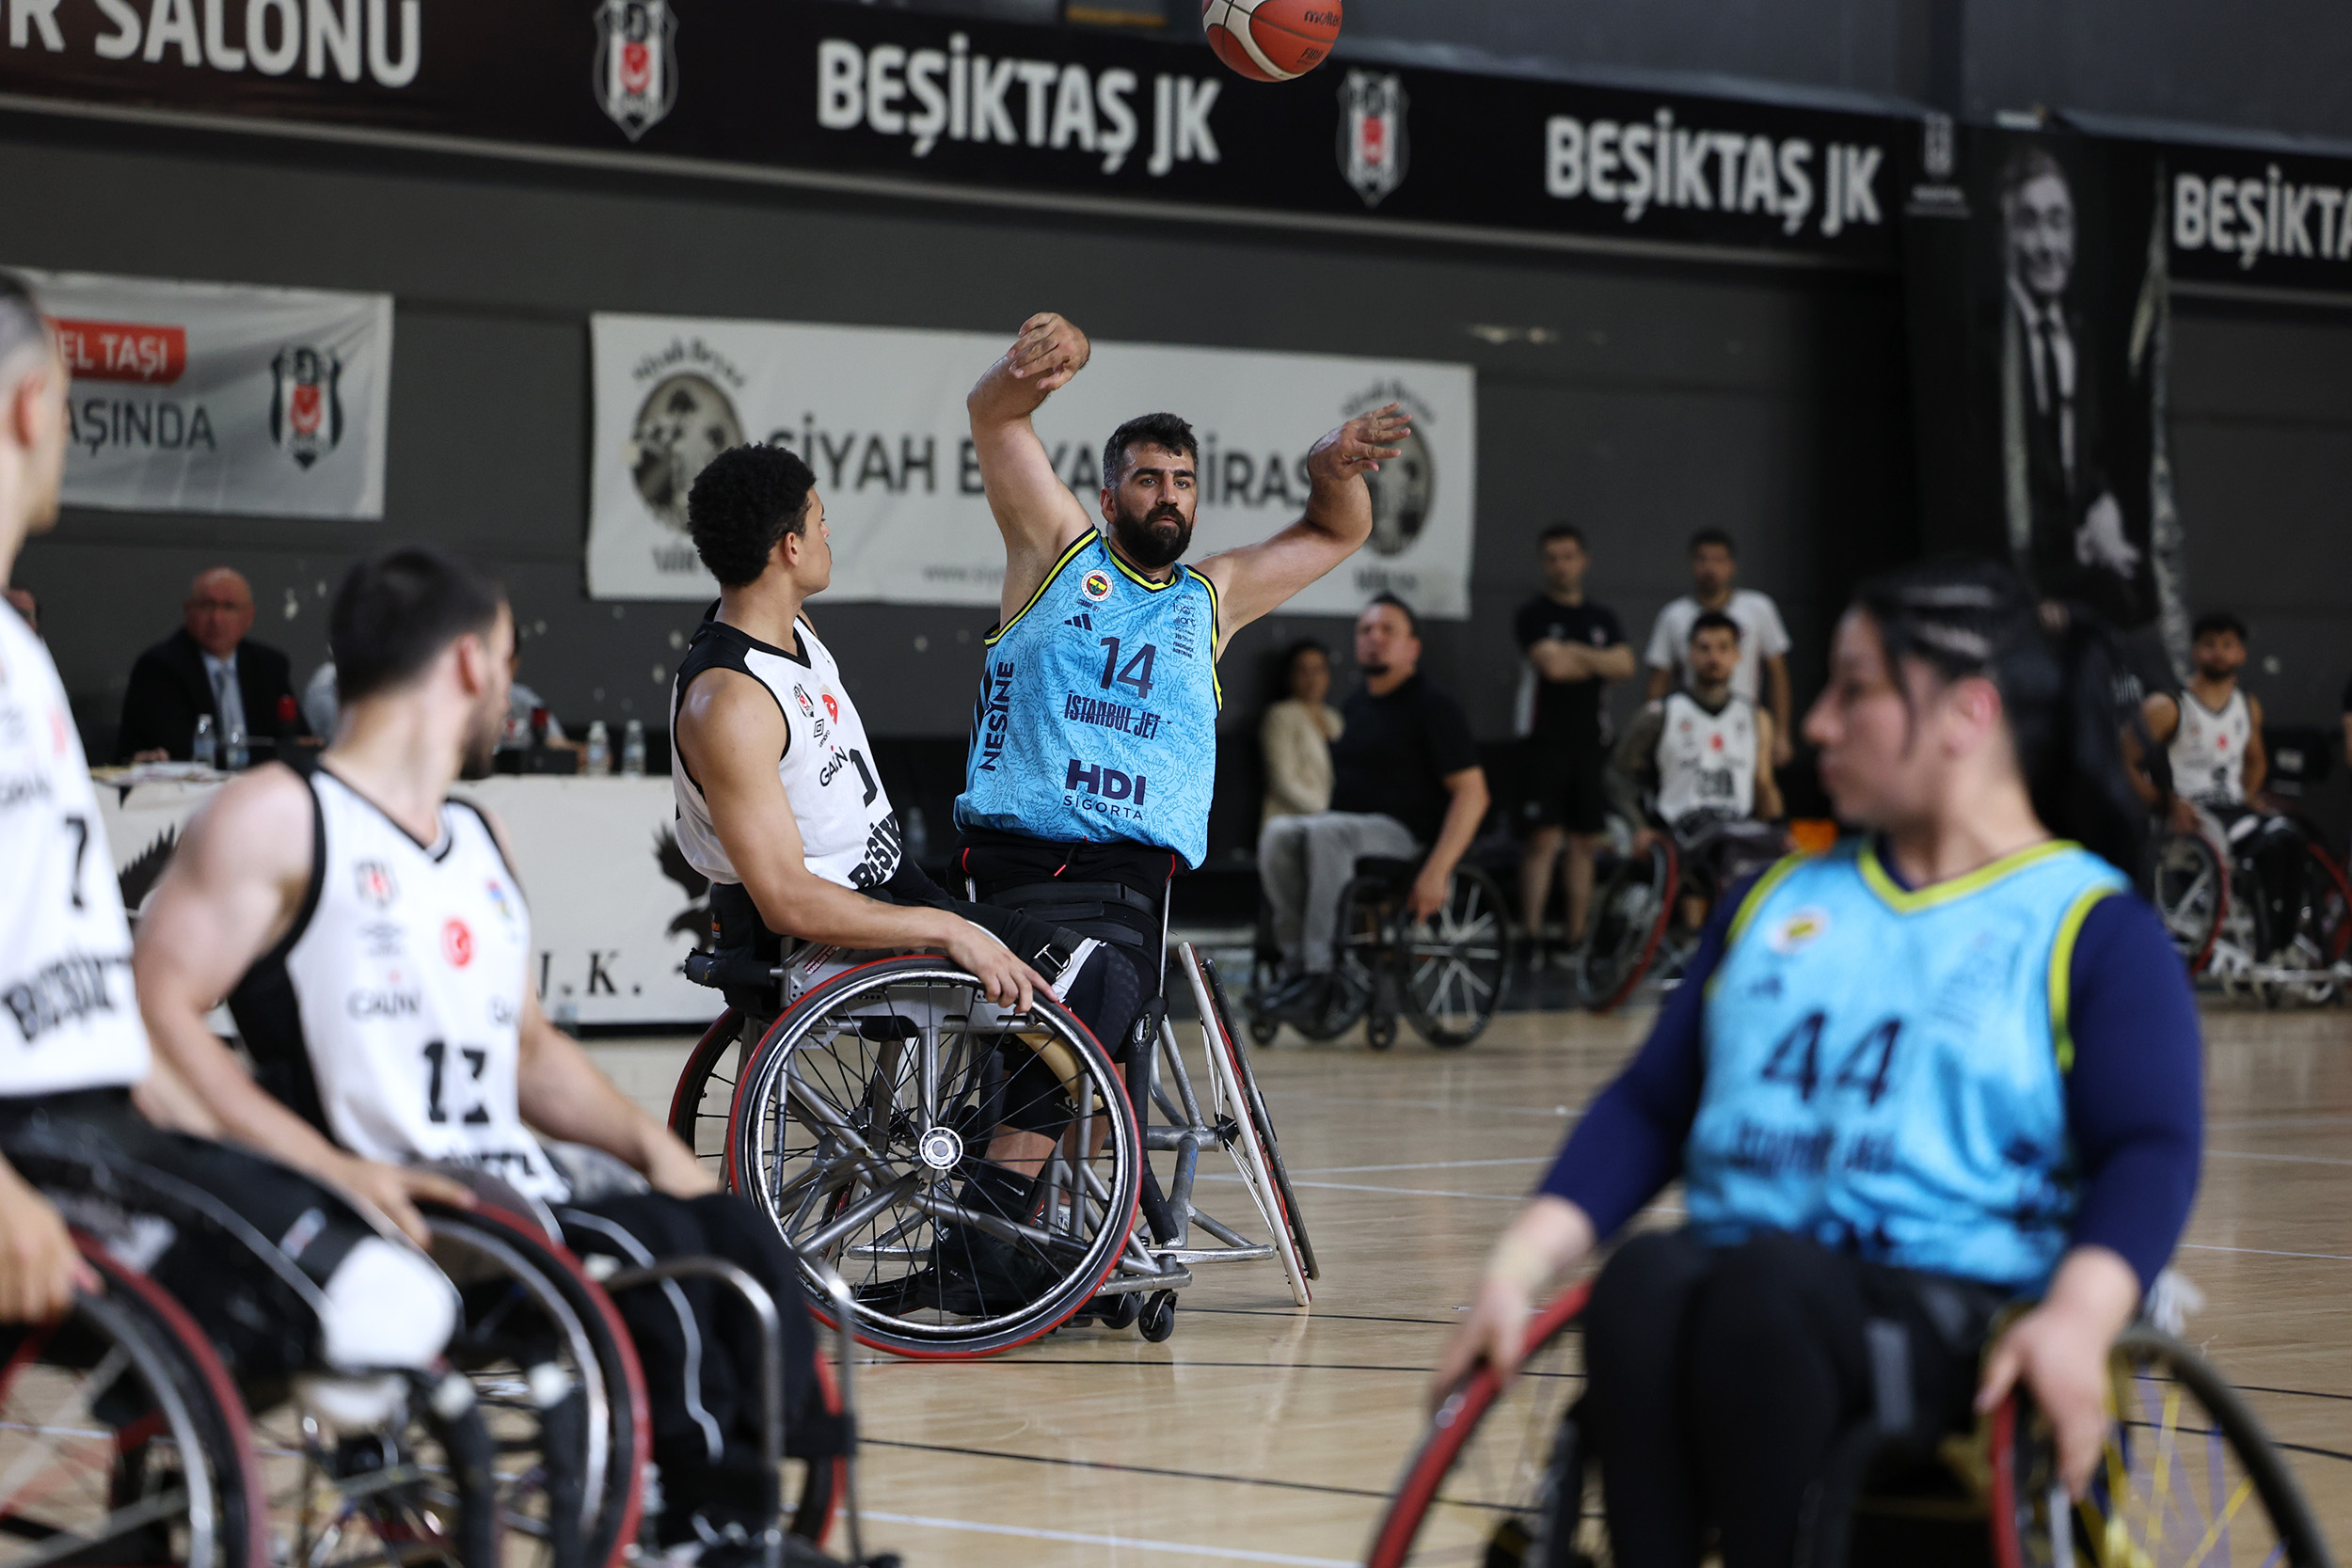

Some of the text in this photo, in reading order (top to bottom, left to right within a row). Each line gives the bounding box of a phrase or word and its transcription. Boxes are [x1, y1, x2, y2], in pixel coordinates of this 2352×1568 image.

[94, 0, 421, 87] SALONU
[817, 34, 1221, 177] BEŞİKTAŞ JK
[1545, 106, 1883, 237] BEŞİKTAŞ JK
[99, 334, 168, 378] TAŞI
[767, 410, 936, 494] İYAH
[1100, 636, 1157, 700] 14
[1134, 711, 1161, 740] JET
[1065, 758, 1147, 806] HDI
[1760, 1010, 1904, 1107] 44
